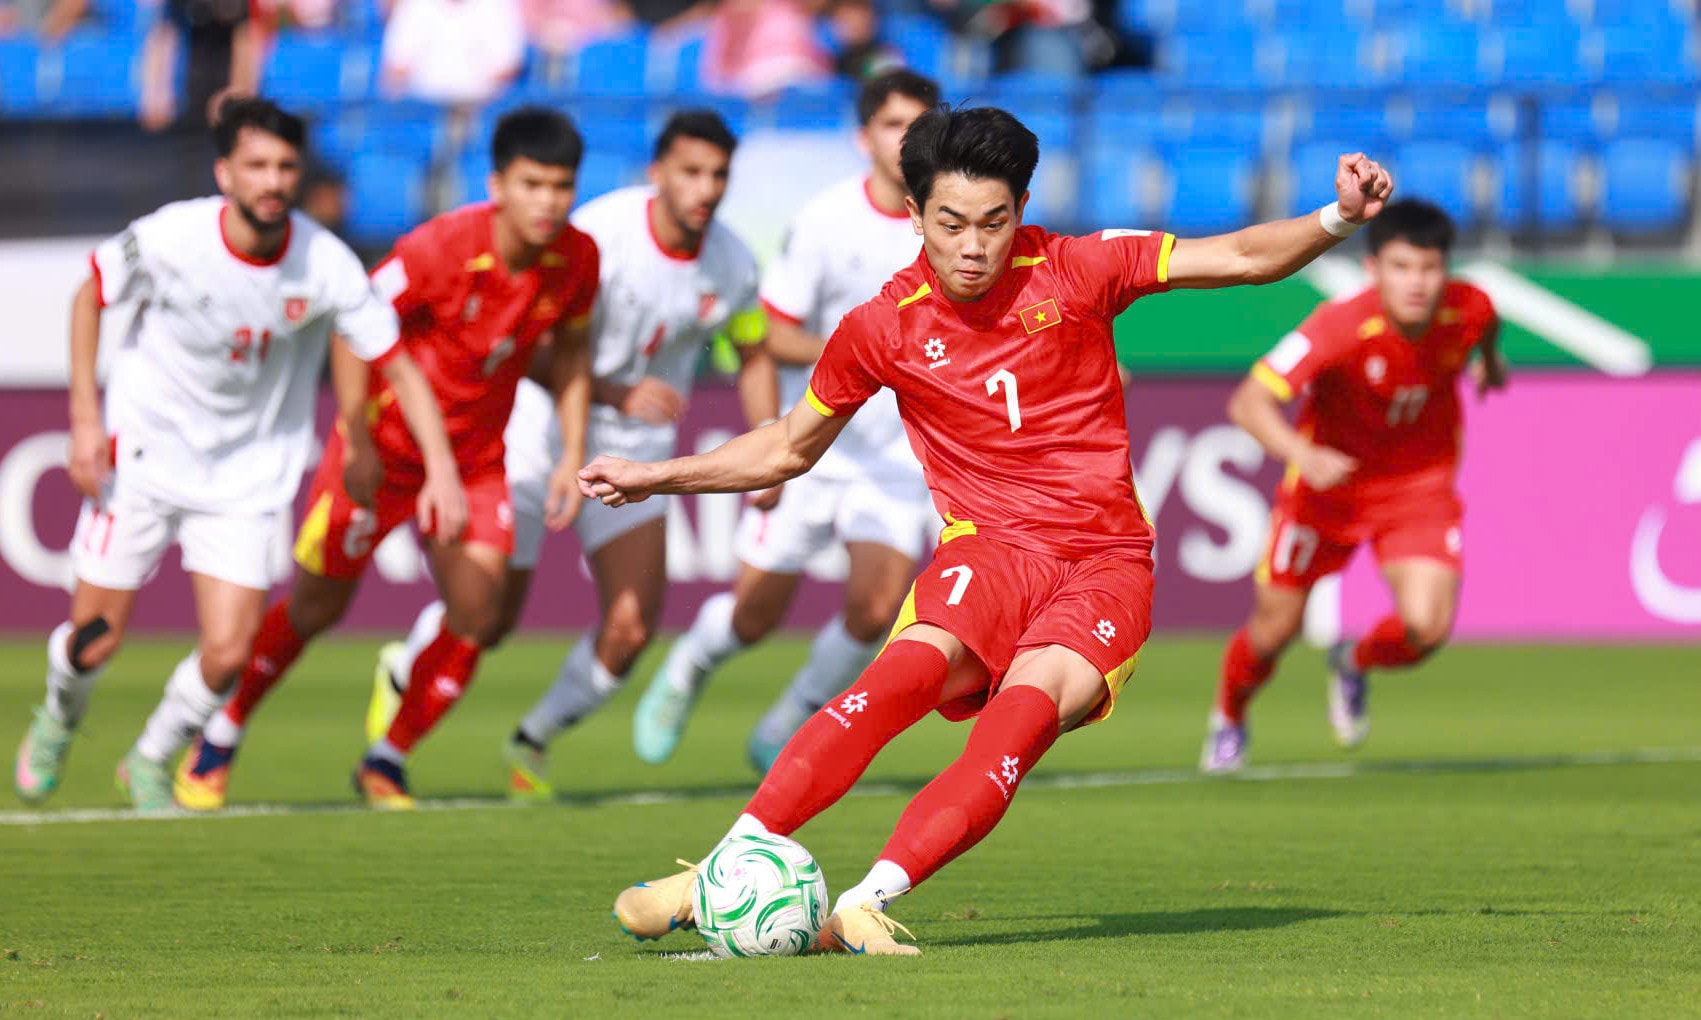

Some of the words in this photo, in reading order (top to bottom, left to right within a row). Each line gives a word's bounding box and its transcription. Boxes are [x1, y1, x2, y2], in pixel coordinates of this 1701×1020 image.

[230, 325, 273, 364] 21
[985, 368, 1022, 433] 7
[940, 564, 973, 606] 7
